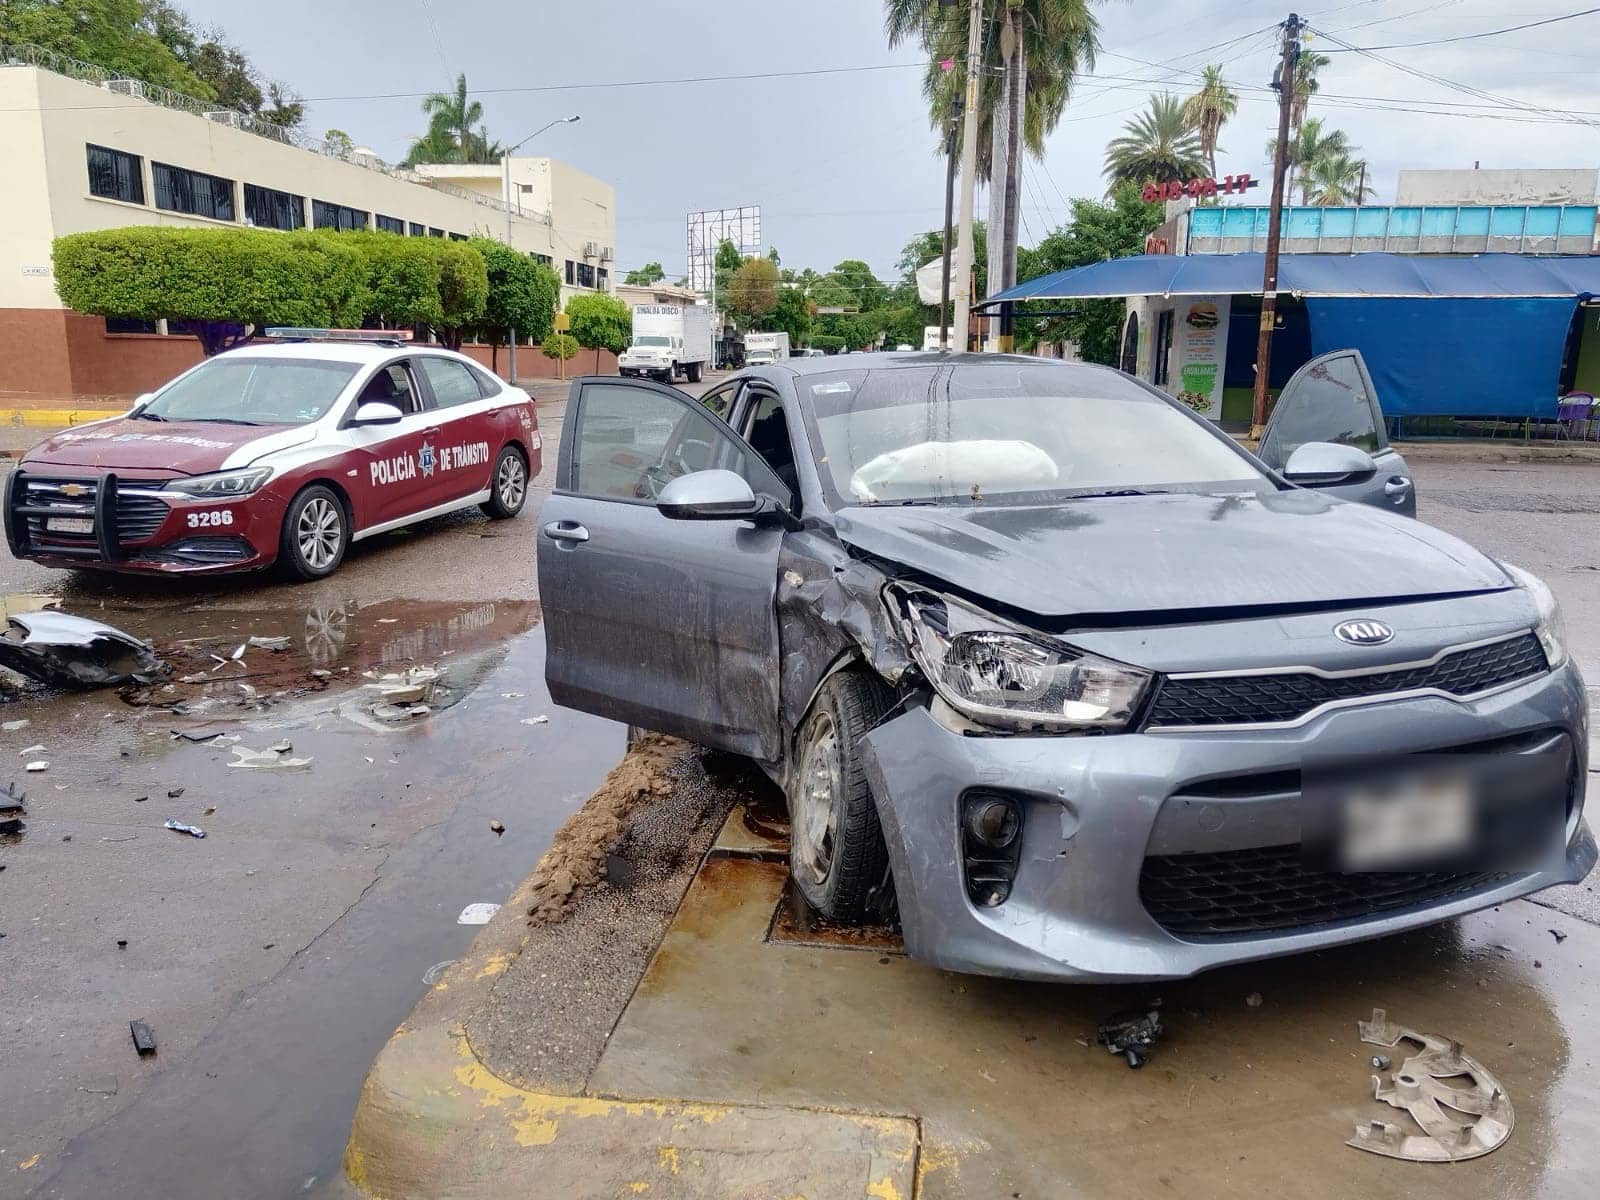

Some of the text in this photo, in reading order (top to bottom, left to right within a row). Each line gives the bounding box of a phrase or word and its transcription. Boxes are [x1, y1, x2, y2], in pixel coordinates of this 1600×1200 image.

[1222, 173, 1251, 194] 17
[661, 306, 679, 315] DISCO
[370, 440, 489, 487] POLICÍA DE TRÁNSITO
[187, 509, 233, 528] 3286
[1343, 622, 1390, 640] KIA
